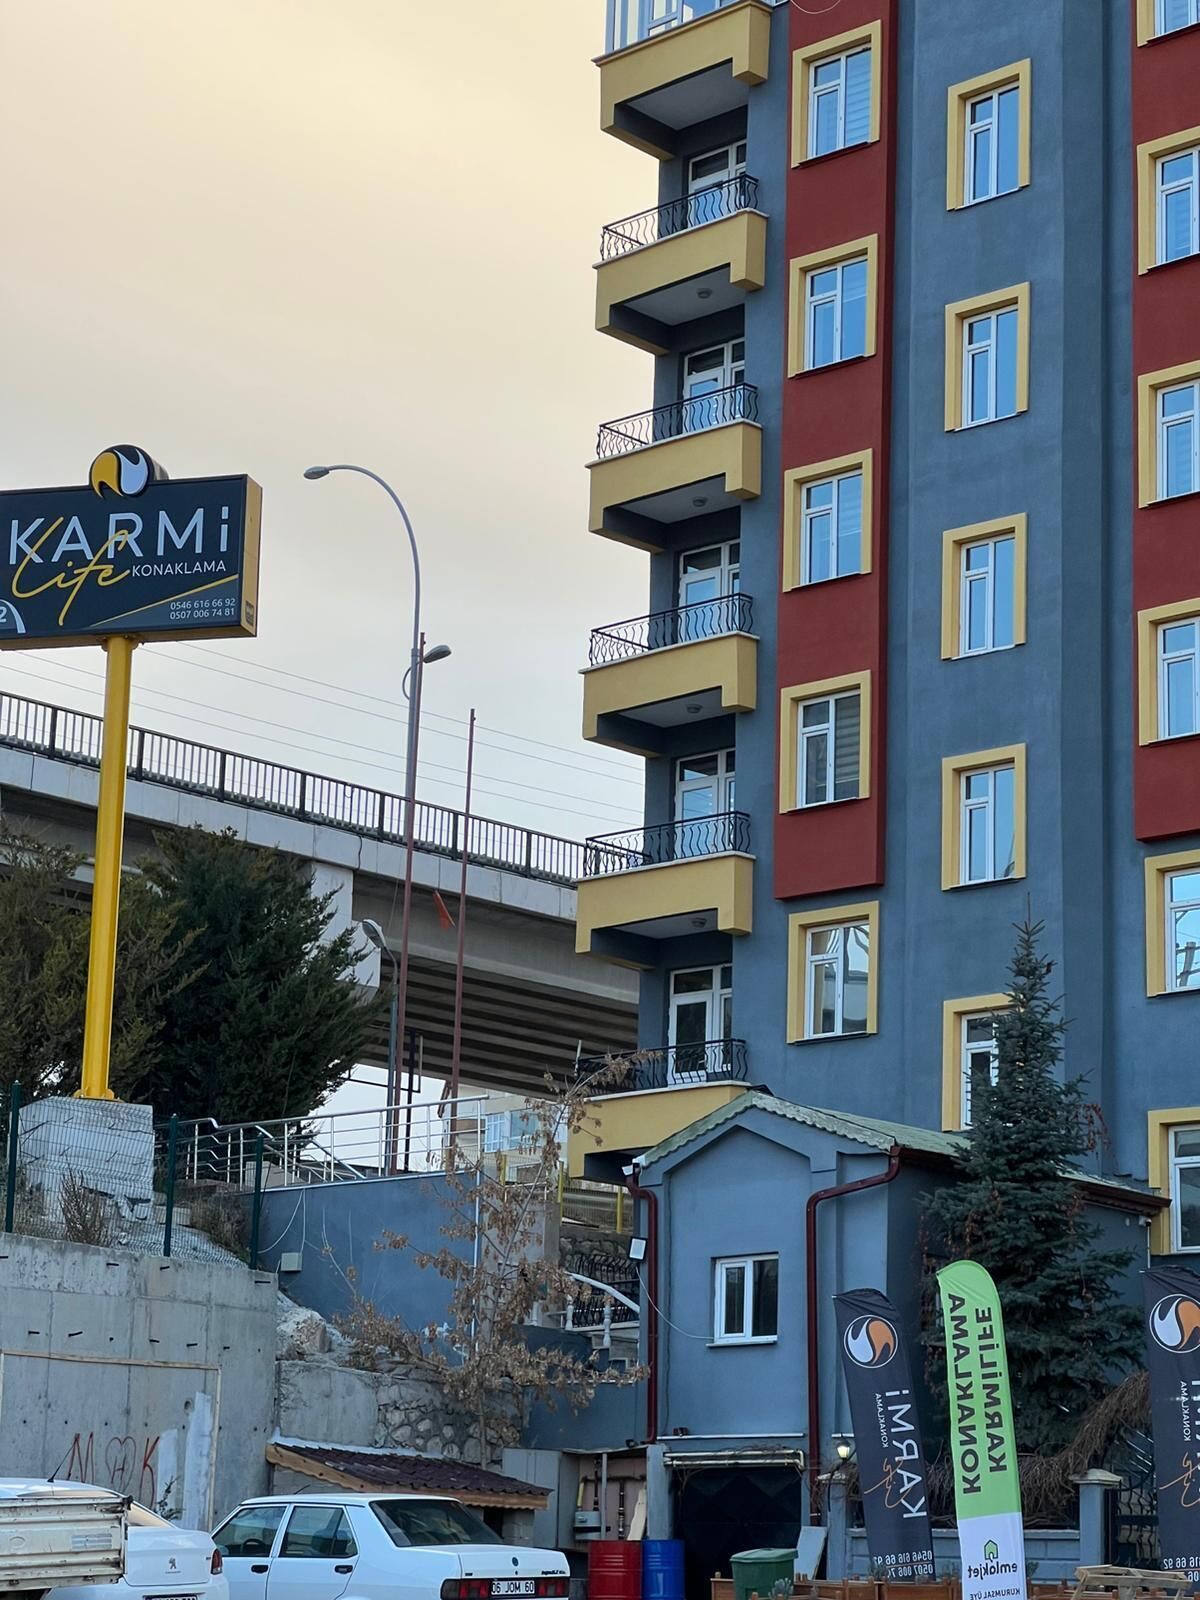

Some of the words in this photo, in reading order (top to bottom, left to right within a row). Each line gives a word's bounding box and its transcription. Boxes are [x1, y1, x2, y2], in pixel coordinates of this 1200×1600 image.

[12, 516, 130, 626] Life
[132, 560, 226, 577] KONAKLAMA
[170, 601, 192, 610] 0546
[193, 600, 210, 609] 616
[211, 599, 223, 607] 66
[224, 598, 236, 607] 92
[169, 610, 191, 620] 0507
[193, 609, 210, 618] 006
[211, 608, 222, 617] 74
[224, 607, 235, 616] 81
[492, 1582, 501, 1594] 06
[505, 1582, 520, 1593] JOM
[524, 1581, 534, 1592] 60
